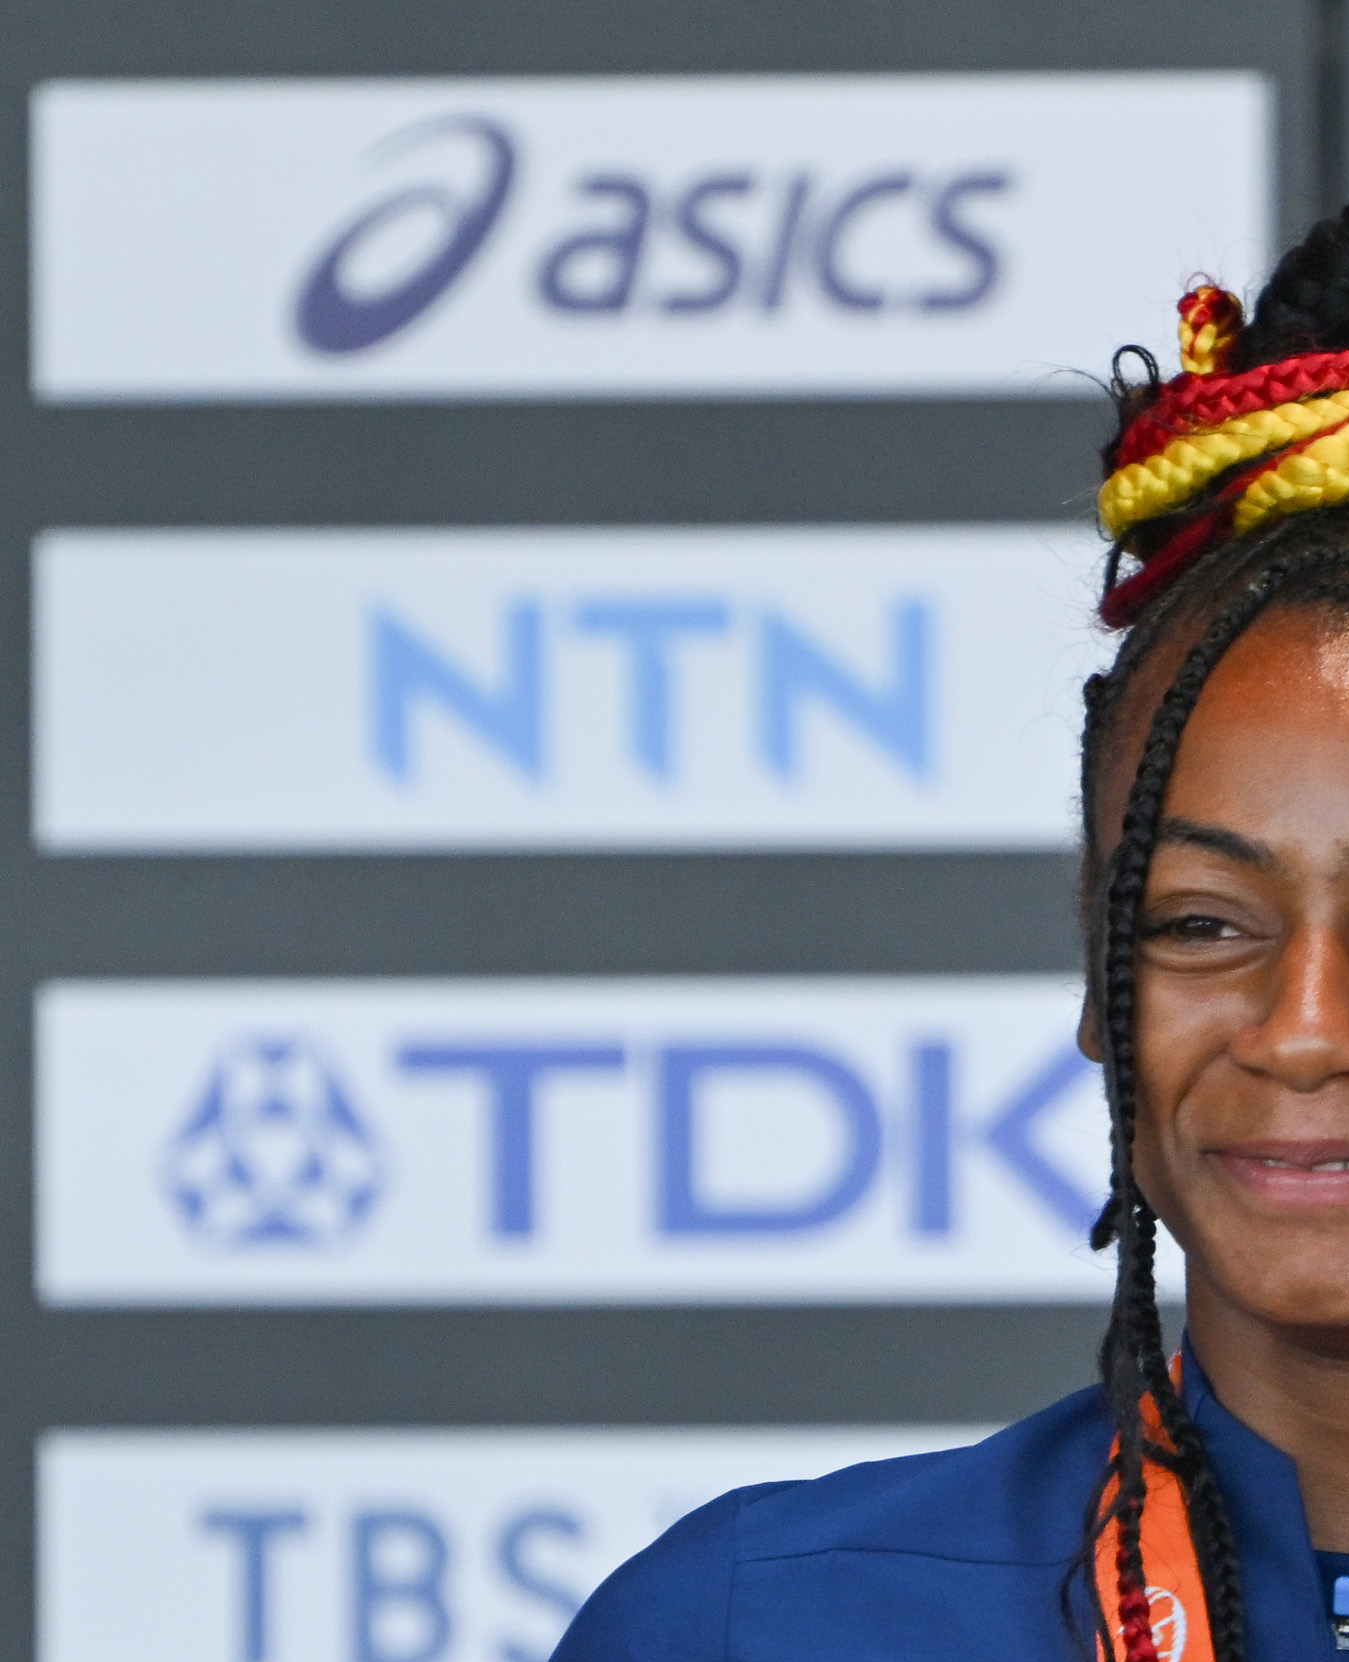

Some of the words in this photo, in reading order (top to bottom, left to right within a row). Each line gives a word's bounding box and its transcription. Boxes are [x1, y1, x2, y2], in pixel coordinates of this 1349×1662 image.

[533, 160, 1016, 317] asics
[366, 591, 936, 787] NTN
[396, 1037, 1107, 1240] TDK
